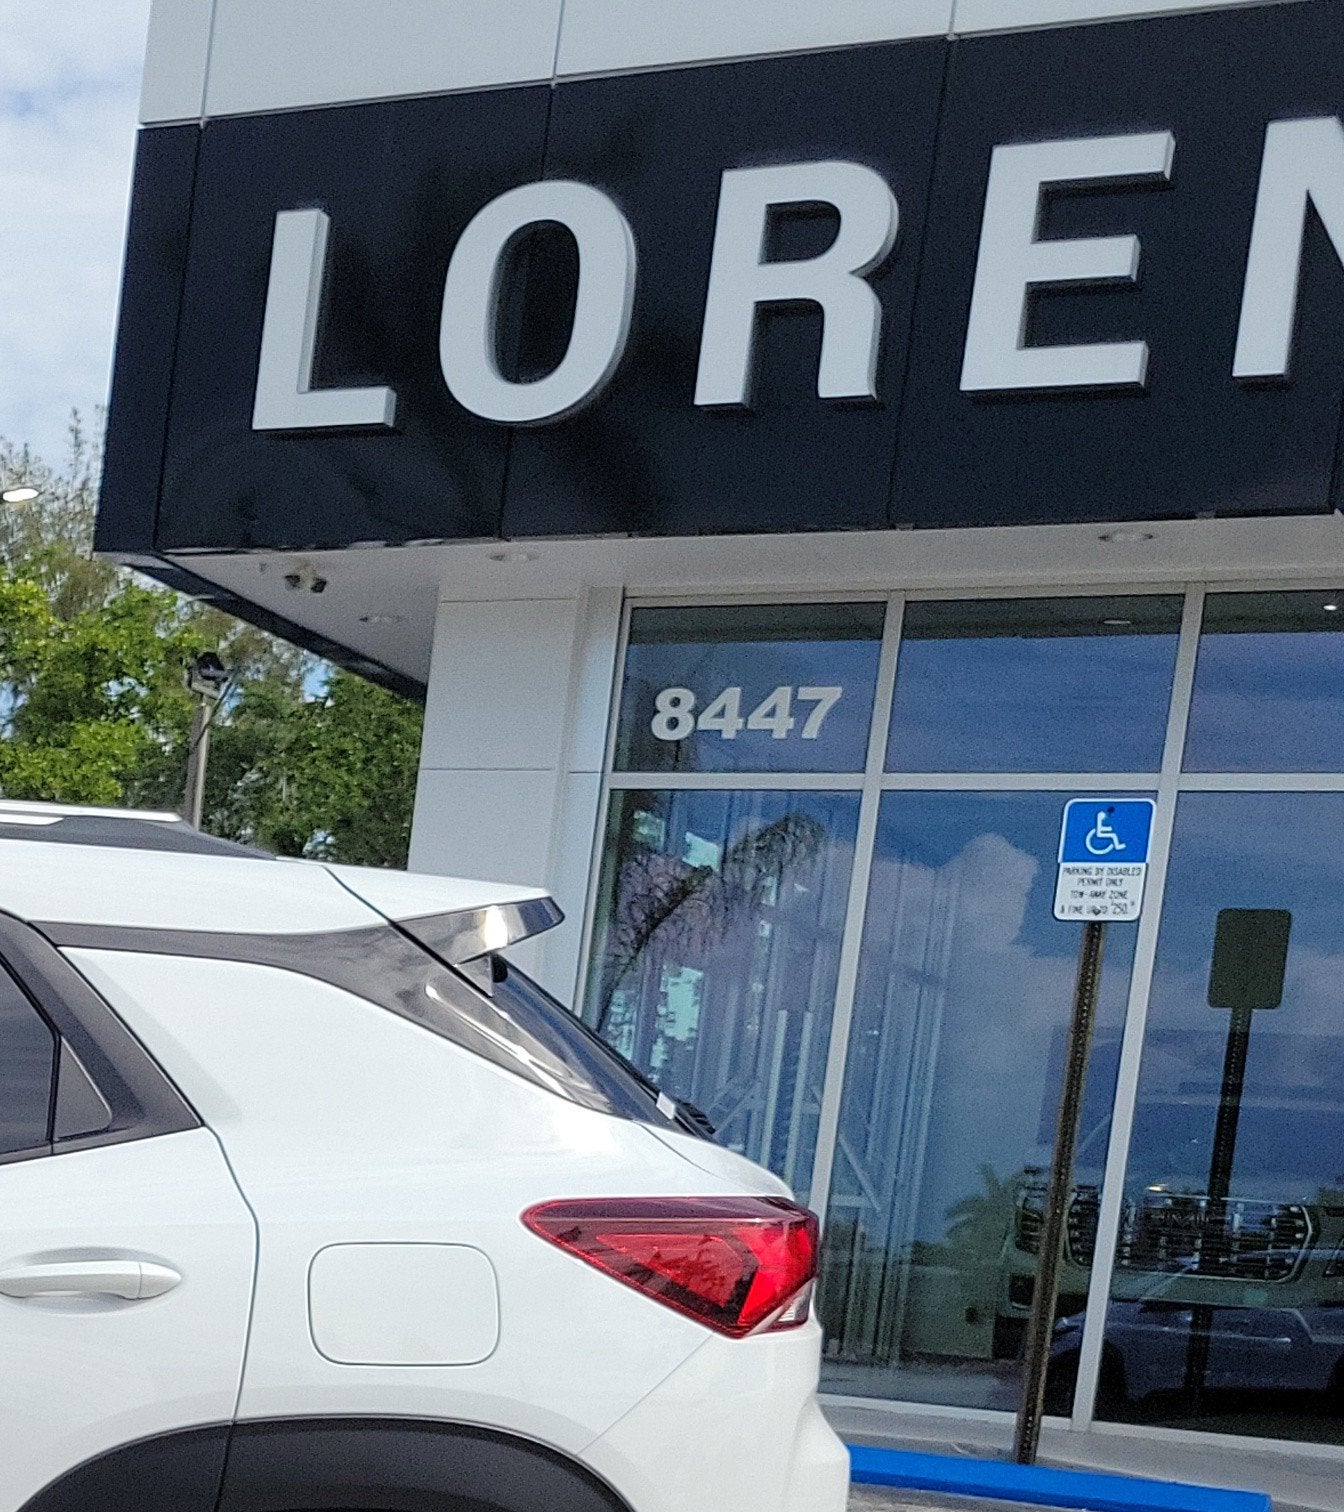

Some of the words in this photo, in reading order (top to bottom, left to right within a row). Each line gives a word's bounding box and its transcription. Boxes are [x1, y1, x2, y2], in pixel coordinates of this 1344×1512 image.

[651, 686, 843, 741] 8447
[1094, 867, 1104, 876] BY
[1106, 867, 1142, 877] DISABLED
